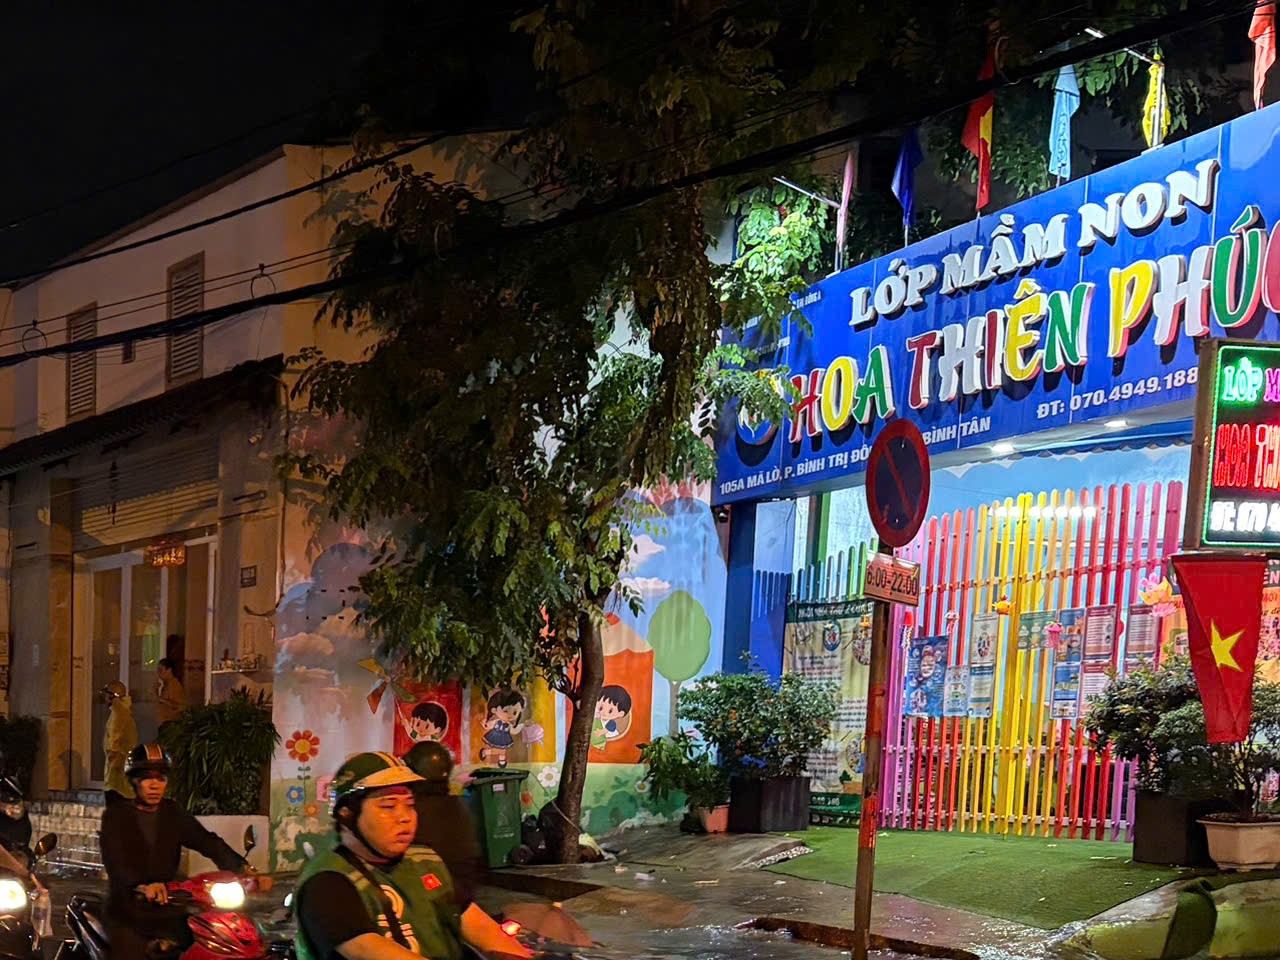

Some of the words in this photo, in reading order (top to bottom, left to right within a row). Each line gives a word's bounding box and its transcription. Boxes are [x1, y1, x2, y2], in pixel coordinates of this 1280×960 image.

[849, 259, 938, 326] LỚP
[940, 214, 1070, 293] MẦM
[1078, 159, 1220, 247] NON
[788, 345, 896, 443] HOA
[907, 278, 1097, 411] THIÊN
[1036, 400, 1065, 420] ĐT:
[1071, 367, 1200, 412] 070.4949.188
[720, 478, 745, 495] 105A
[784, 465, 796, 480] P.
[797, 454, 825, 476] BÌNH
[828, 451, 849, 469] TRỊ
[923, 422, 957, 446] BÌNH
[959, 415, 991, 438] TÂN
